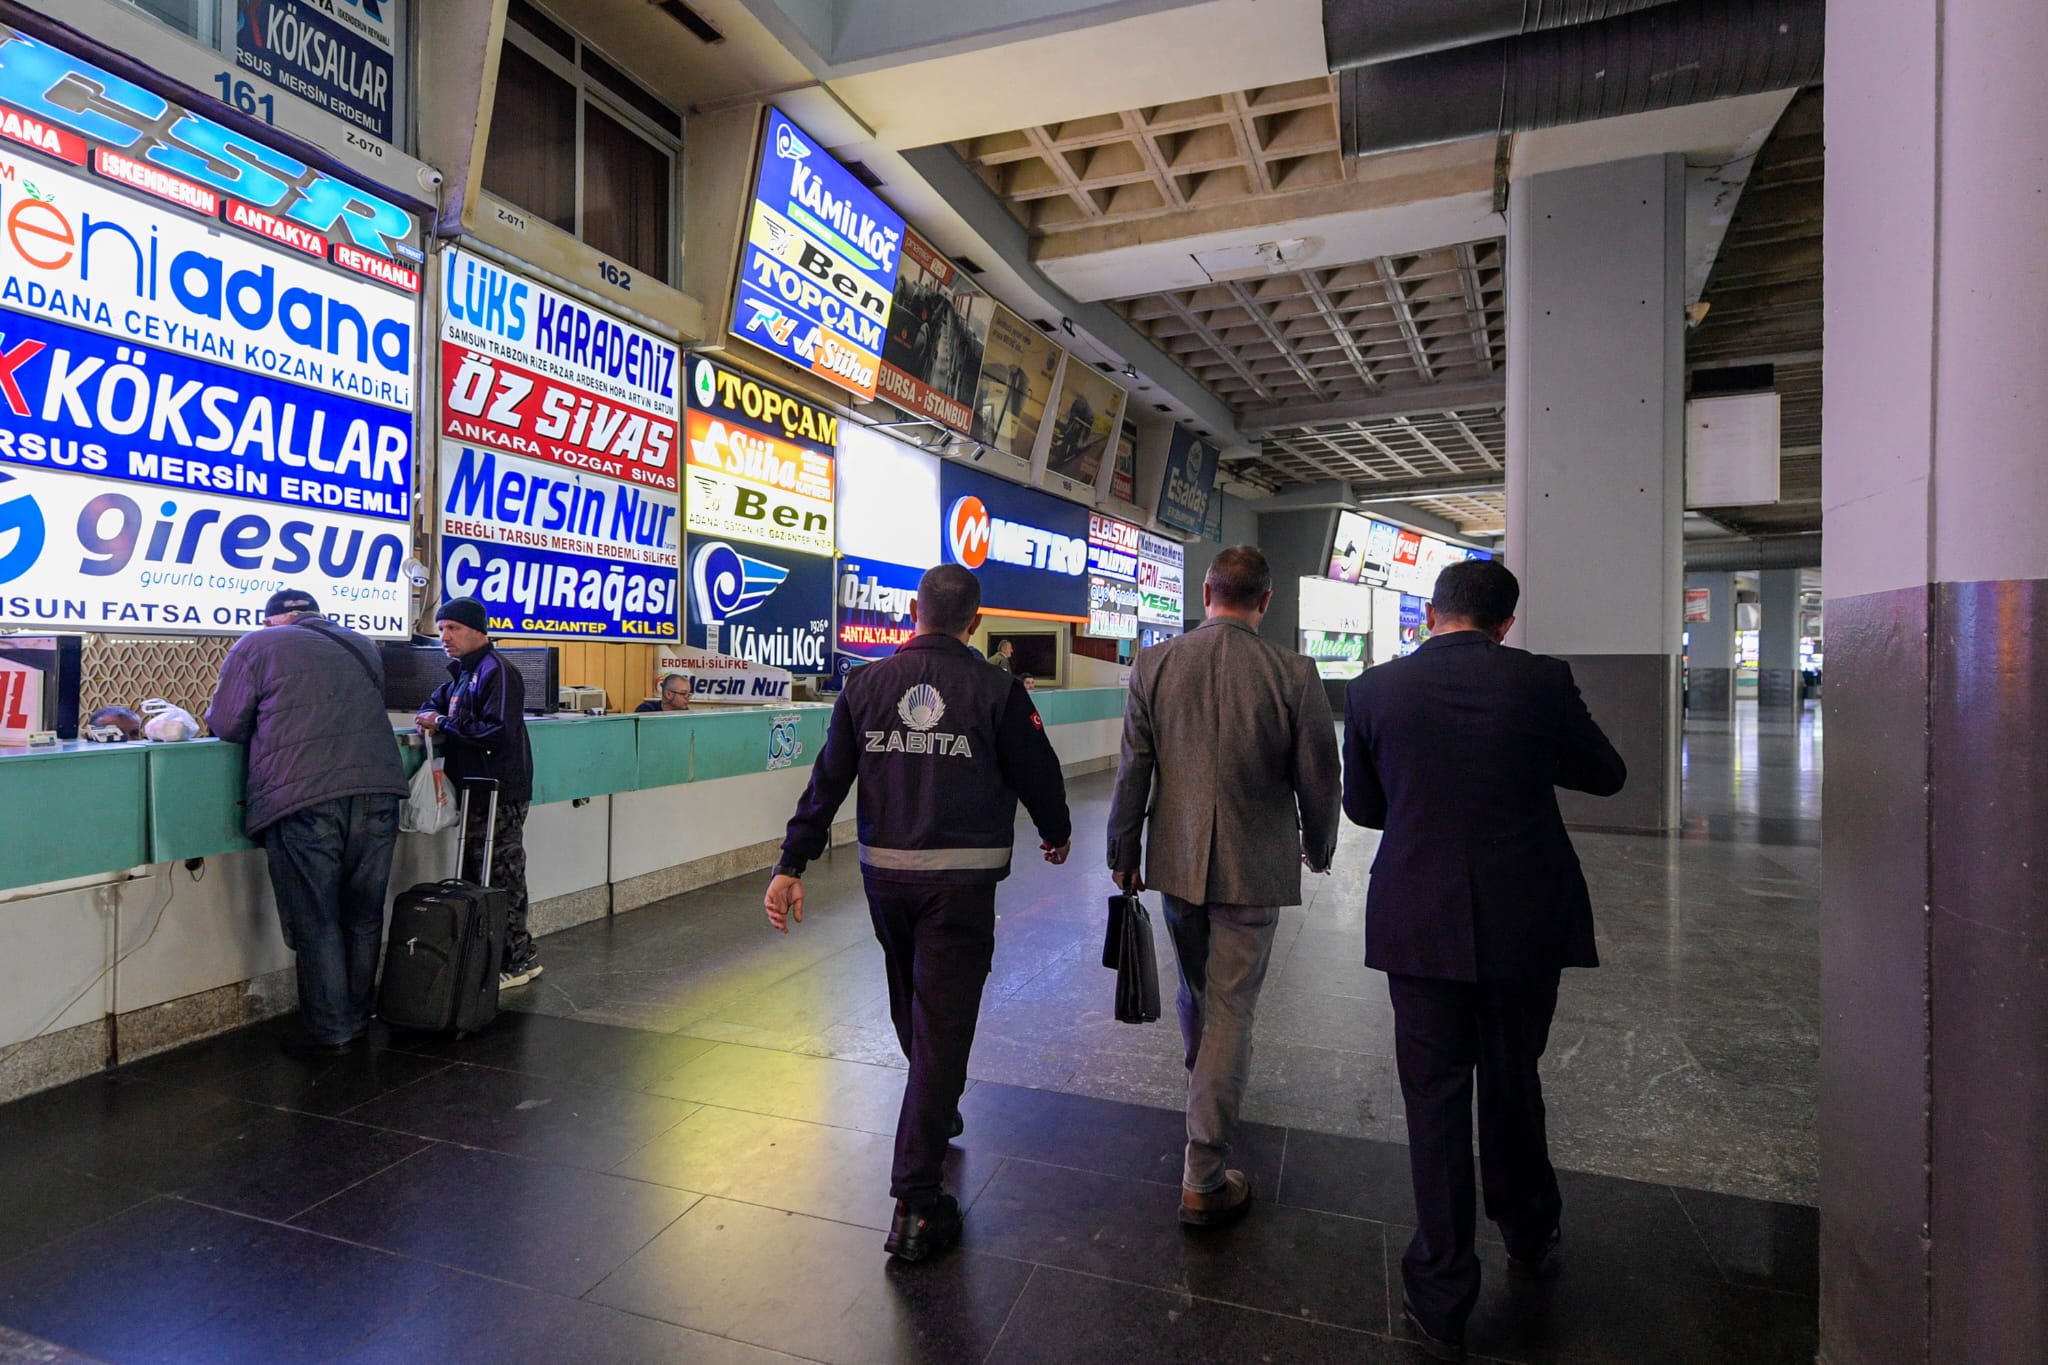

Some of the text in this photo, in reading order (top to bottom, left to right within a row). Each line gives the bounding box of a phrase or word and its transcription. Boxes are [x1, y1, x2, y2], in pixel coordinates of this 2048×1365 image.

[267, 3, 388, 112] KÖKSALLAR
[214, 72, 274, 126] 161
[279, 70, 327, 106] MERSİN
[346, 132, 383, 158] Z-070
[497, 209, 525, 230] Z-071
[232, 205, 323, 256] ANTAKYA
[339, 246, 417, 290] REYHANLI
[447, 252, 528, 342] LÜKS
[598, 261, 631, 291] 162
[753, 251, 882, 351] TOPÇAM
[798, 239, 885, 317] Ben
[2, 276, 113, 328] ADANA
[125, 309, 235, 361] CEYHAN
[245, 348, 323, 385] KOZAN
[448, 351, 534, 428] ÖZ
[449, 326, 487, 350] SAMSUN
[489, 340, 529, 366] TRABZON
[549, 362, 574, 382] PAZAR
[609, 384, 626, 399] HOPA
[878, 366, 917, 405] BURSA
[42, 346, 409, 485] KÖKSALLAR
[717, 370, 838, 447] TOPÇAM
[129, 452, 268, 496] MERSİN
[447, 419, 542, 456] ANKARA
[550, 446, 623, 476] YOZGAT
[445, 447, 676, 549] Mersin Nur
[734, 485, 828, 532] Ben
[76, 493, 403, 584] giresun
[499, 527, 548, 547] TARSUS
[988, 517, 1088, 577] METRO
[140, 571, 204, 589] gururla
[332, 584, 398, 603] seyahat
[102, 601, 201, 624] FATSA
[751, 676, 790, 697] Nur
[865, 731, 973, 758] ZABITA
